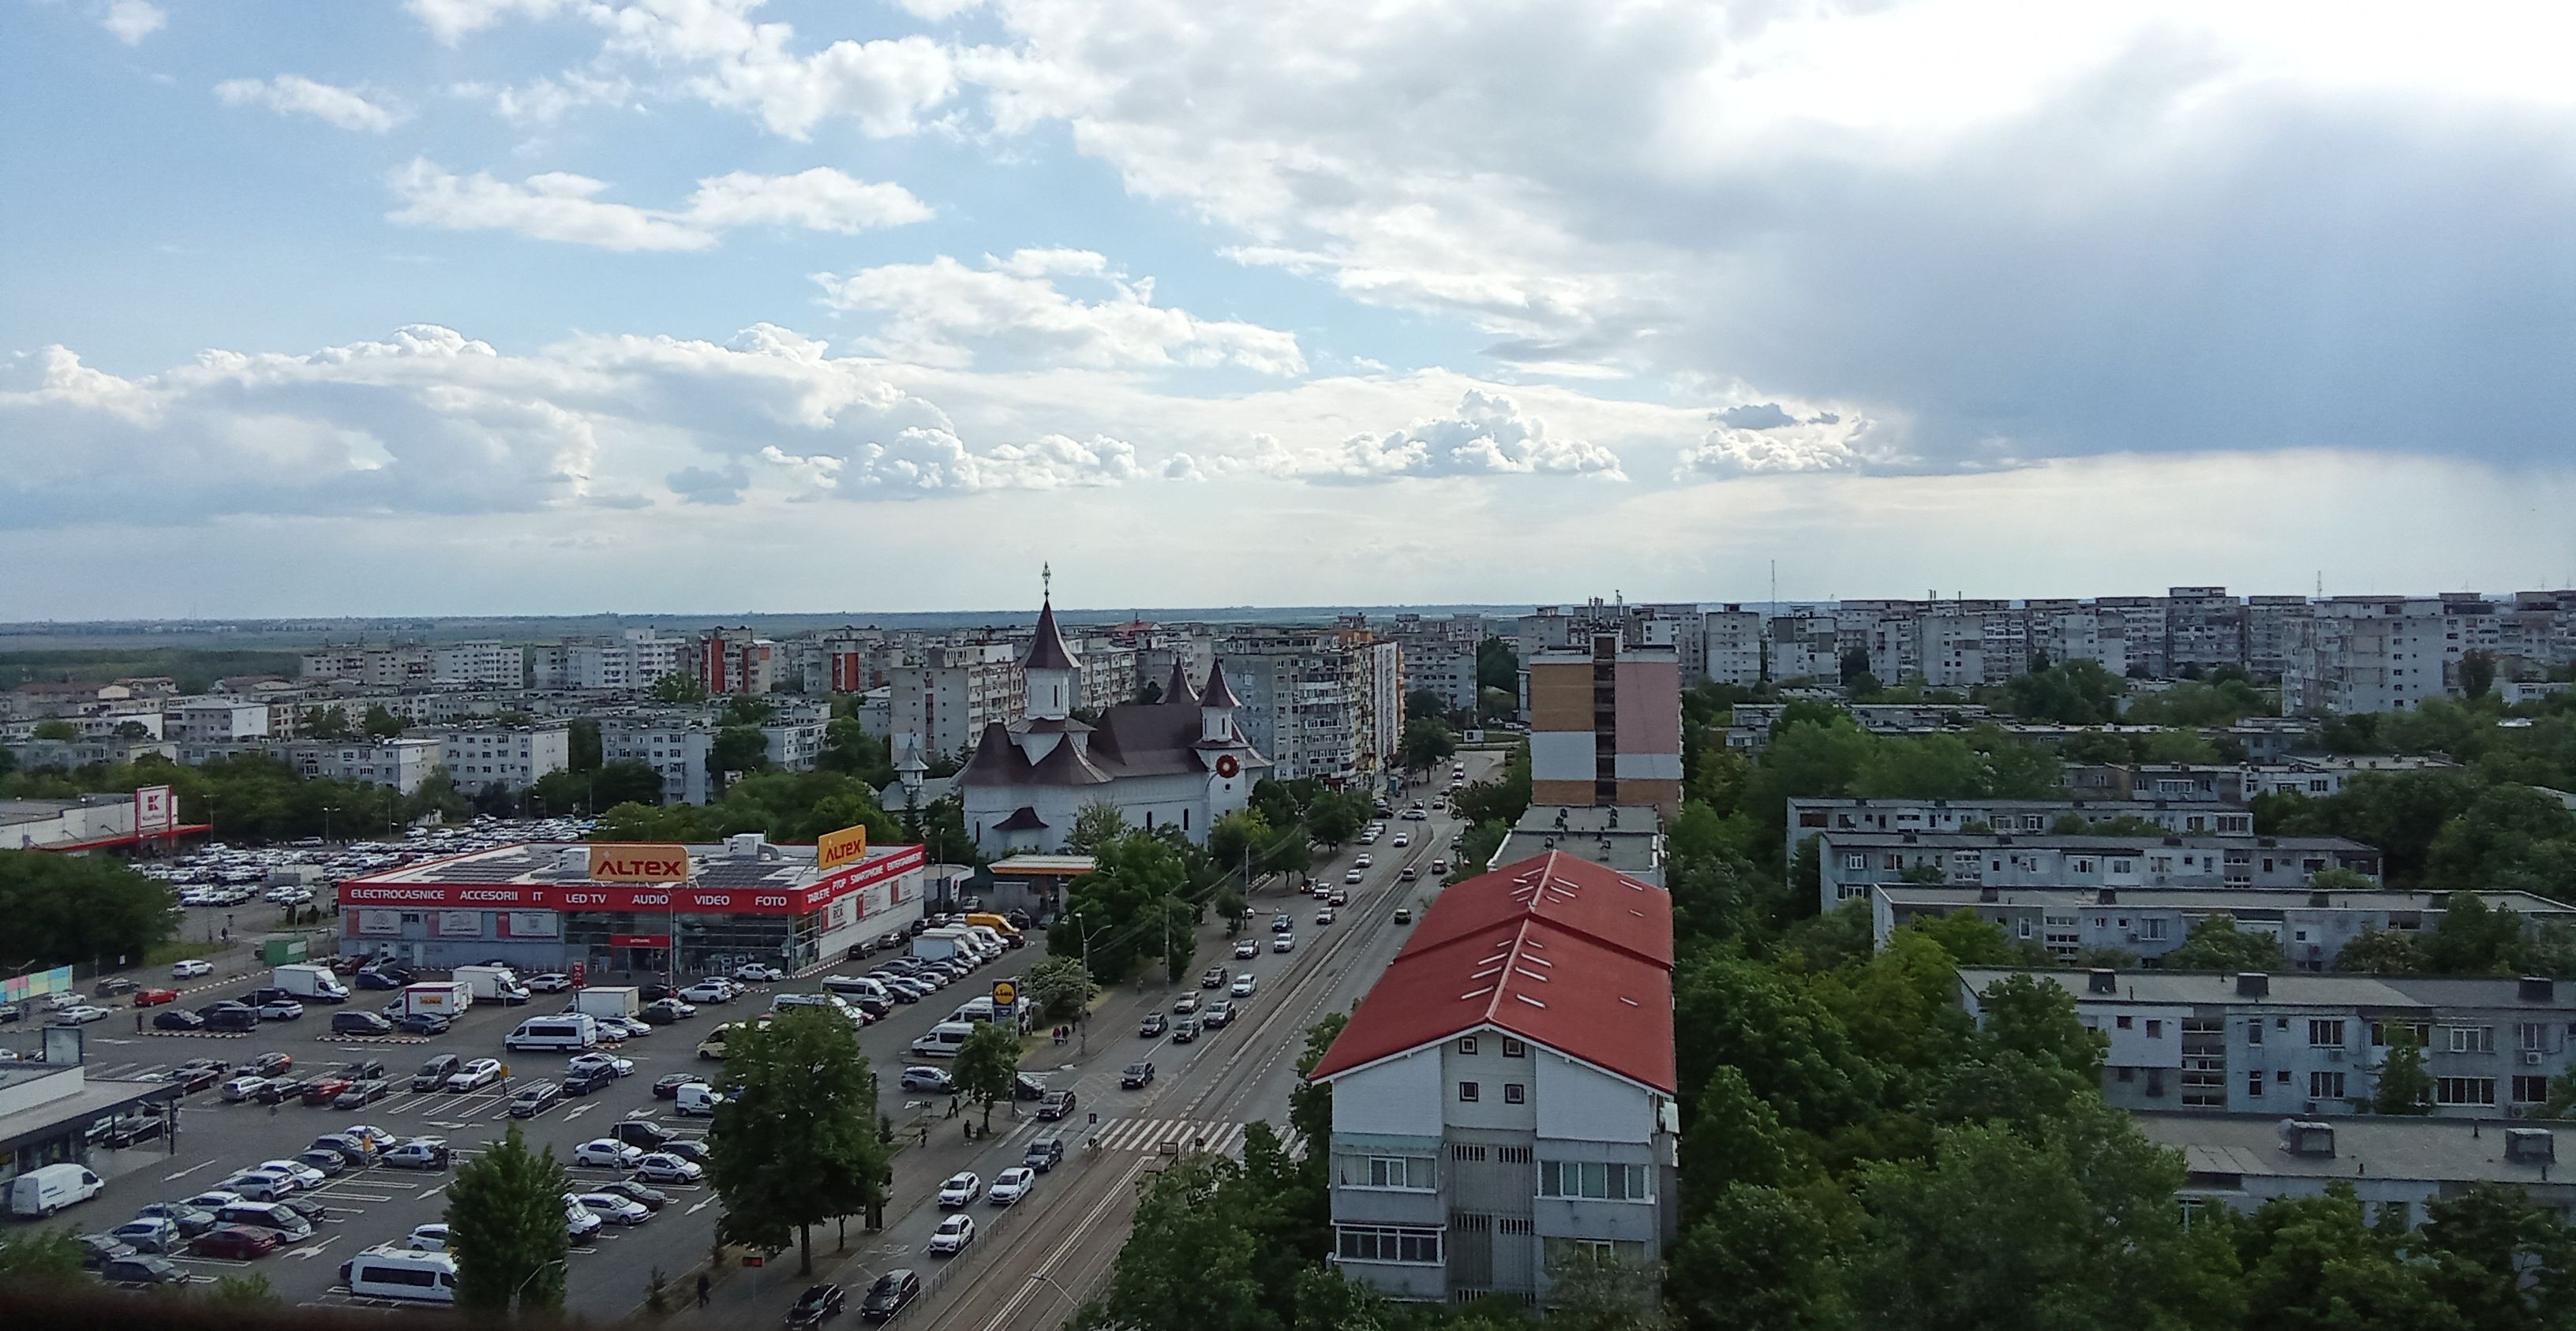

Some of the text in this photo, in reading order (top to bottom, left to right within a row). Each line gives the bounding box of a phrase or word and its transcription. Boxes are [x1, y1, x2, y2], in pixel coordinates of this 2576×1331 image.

[350, 889, 787, 907] ELECTROCASNICE ACCESORII IT LED TV AUDIO VIDEO FOTO
